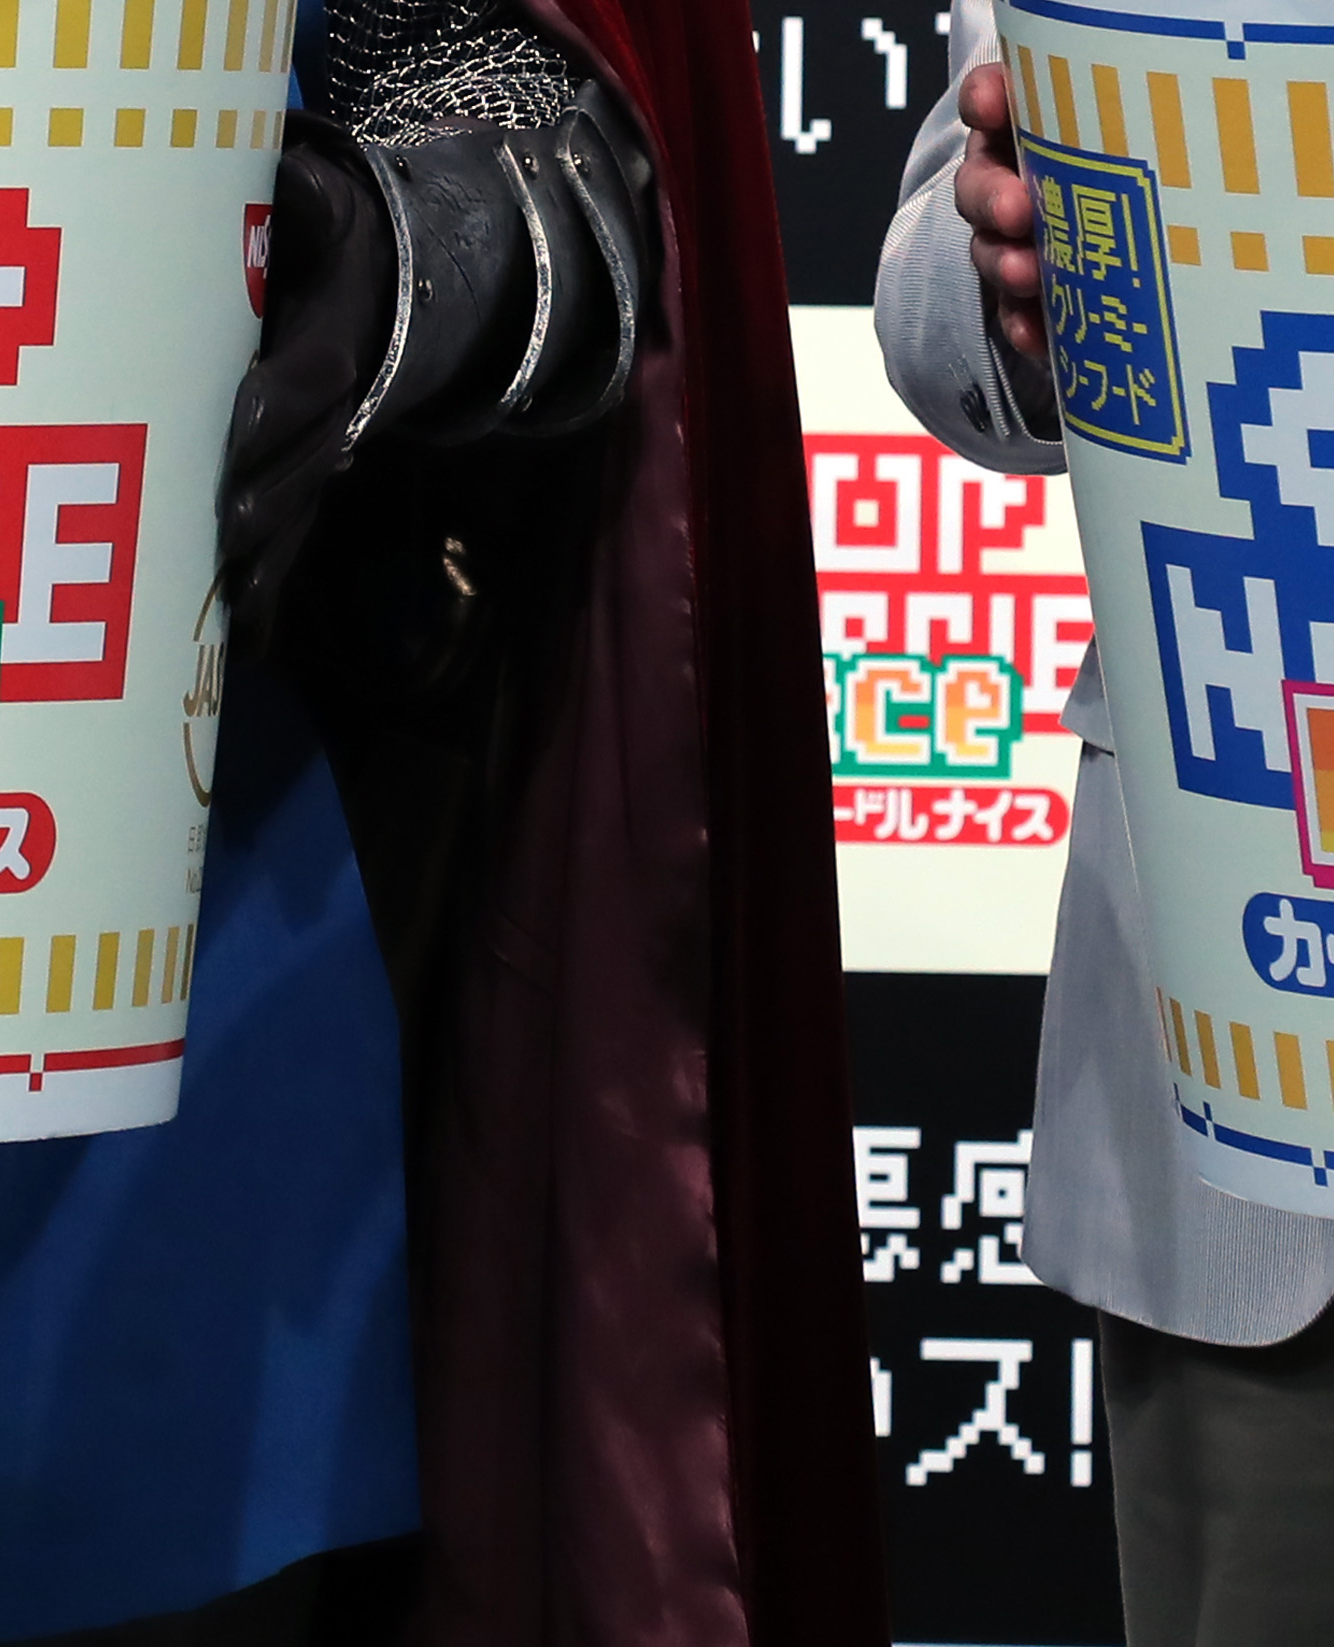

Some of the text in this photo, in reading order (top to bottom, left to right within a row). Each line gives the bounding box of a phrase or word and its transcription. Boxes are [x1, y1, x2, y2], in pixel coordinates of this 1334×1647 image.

[1034, 174, 1141, 289] 濃厚!
[1051, 273, 1148, 353] クリーミー
